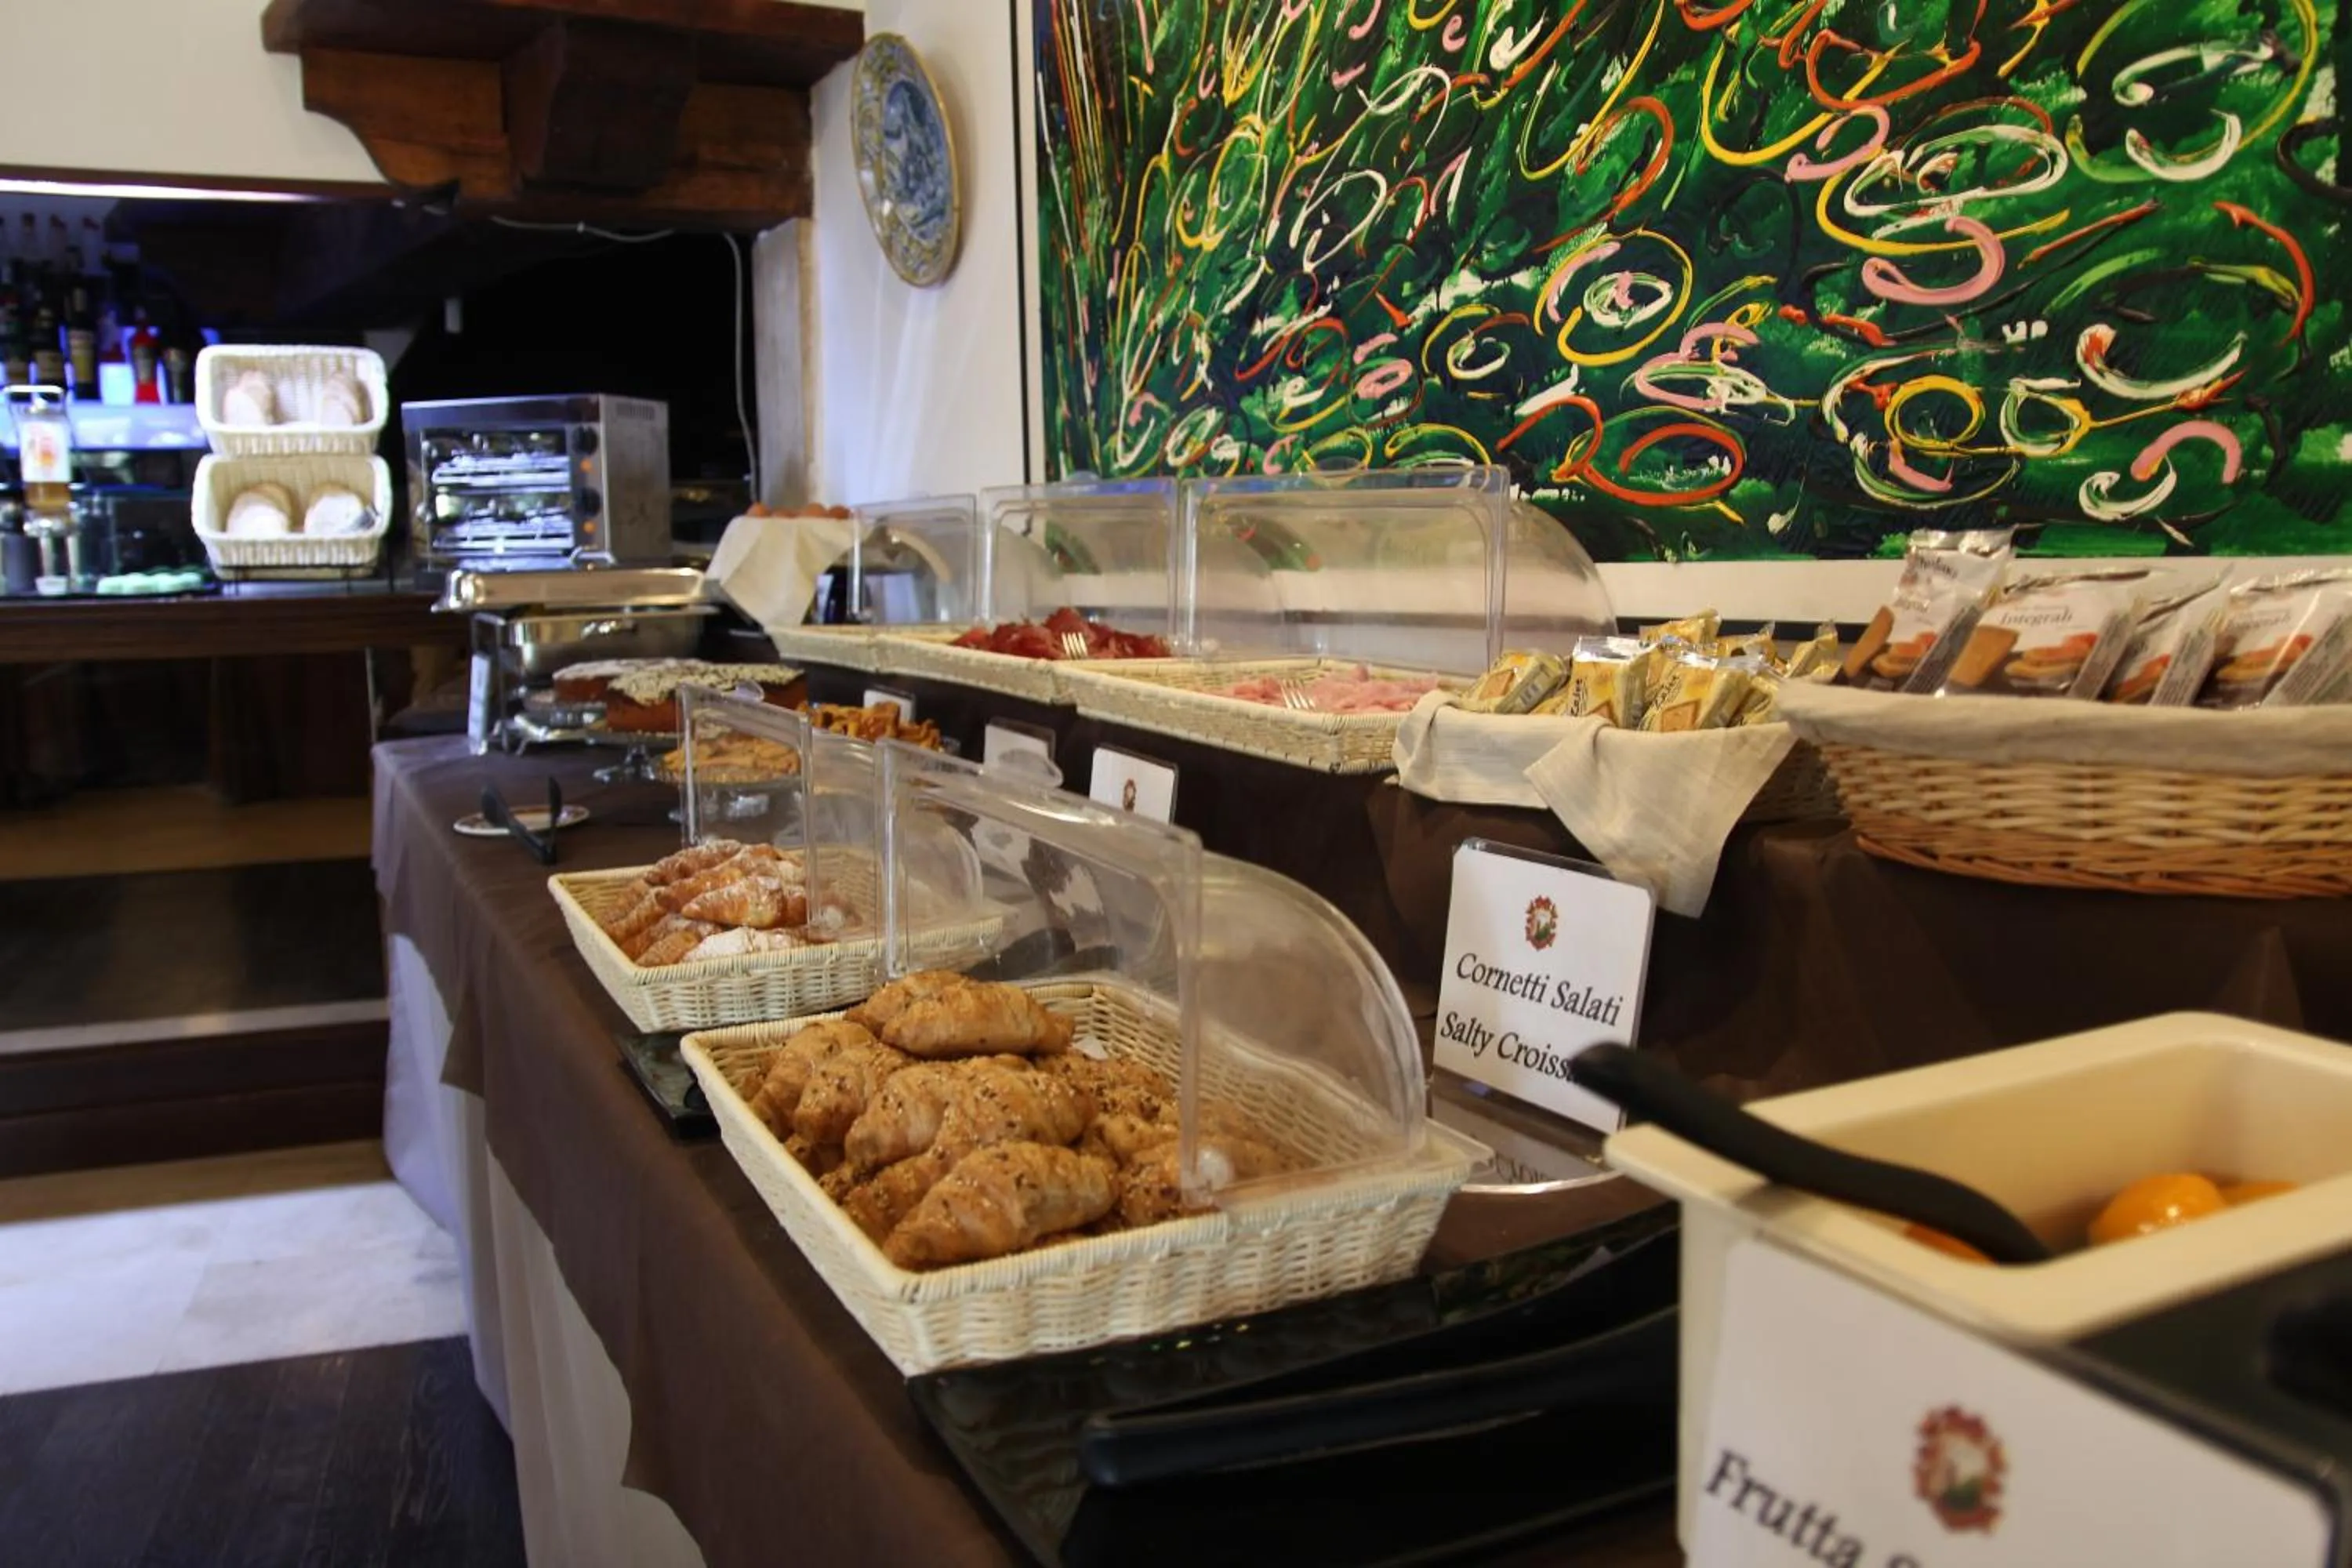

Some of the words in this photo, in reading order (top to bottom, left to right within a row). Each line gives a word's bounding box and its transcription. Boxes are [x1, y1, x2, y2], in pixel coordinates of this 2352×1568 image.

[1456, 953, 1550, 1003] Cornetti
[1550, 980, 1624, 1026] Salati
[1440, 1011, 1494, 1058] Salty
[1497, 1032, 1571, 1082] Croiss
[1704, 1449, 1864, 1568] Frutta
